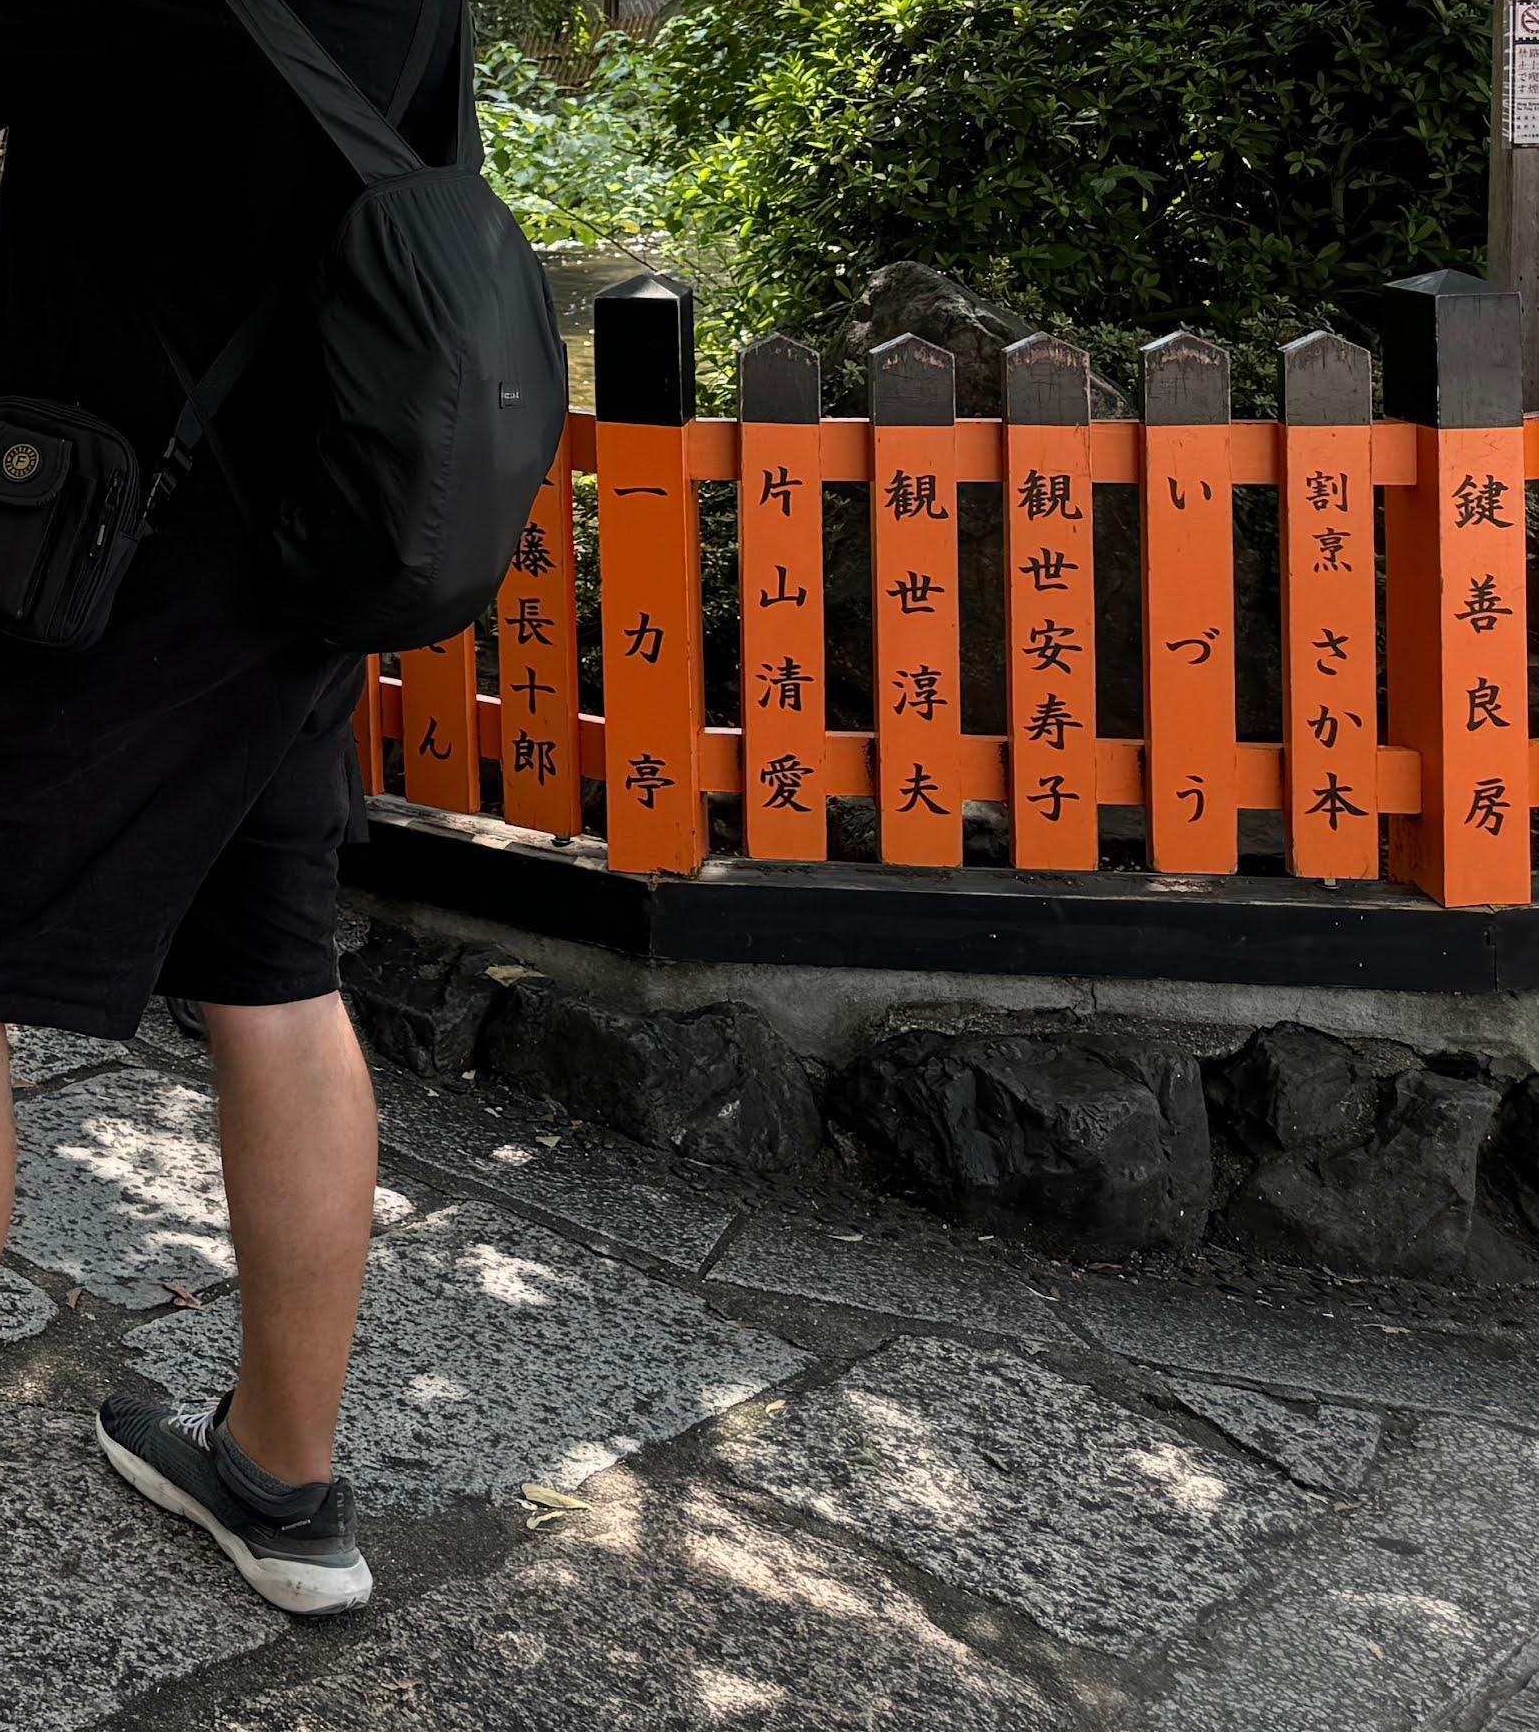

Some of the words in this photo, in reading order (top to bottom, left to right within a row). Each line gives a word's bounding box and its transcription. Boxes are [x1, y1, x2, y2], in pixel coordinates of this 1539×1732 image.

[505, 476, 557, 786] 藤長十郎
[613, 487, 676, 810] 一力亭
[756, 466, 815, 813] 片山清愛
[885, 469, 951, 815] 観世淳夫
[1017, 469, 1084, 822] 観世安寿子
[1165, 476, 1220, 822] いづう
[1451, 474, 1514, 836] 鍵善良房
